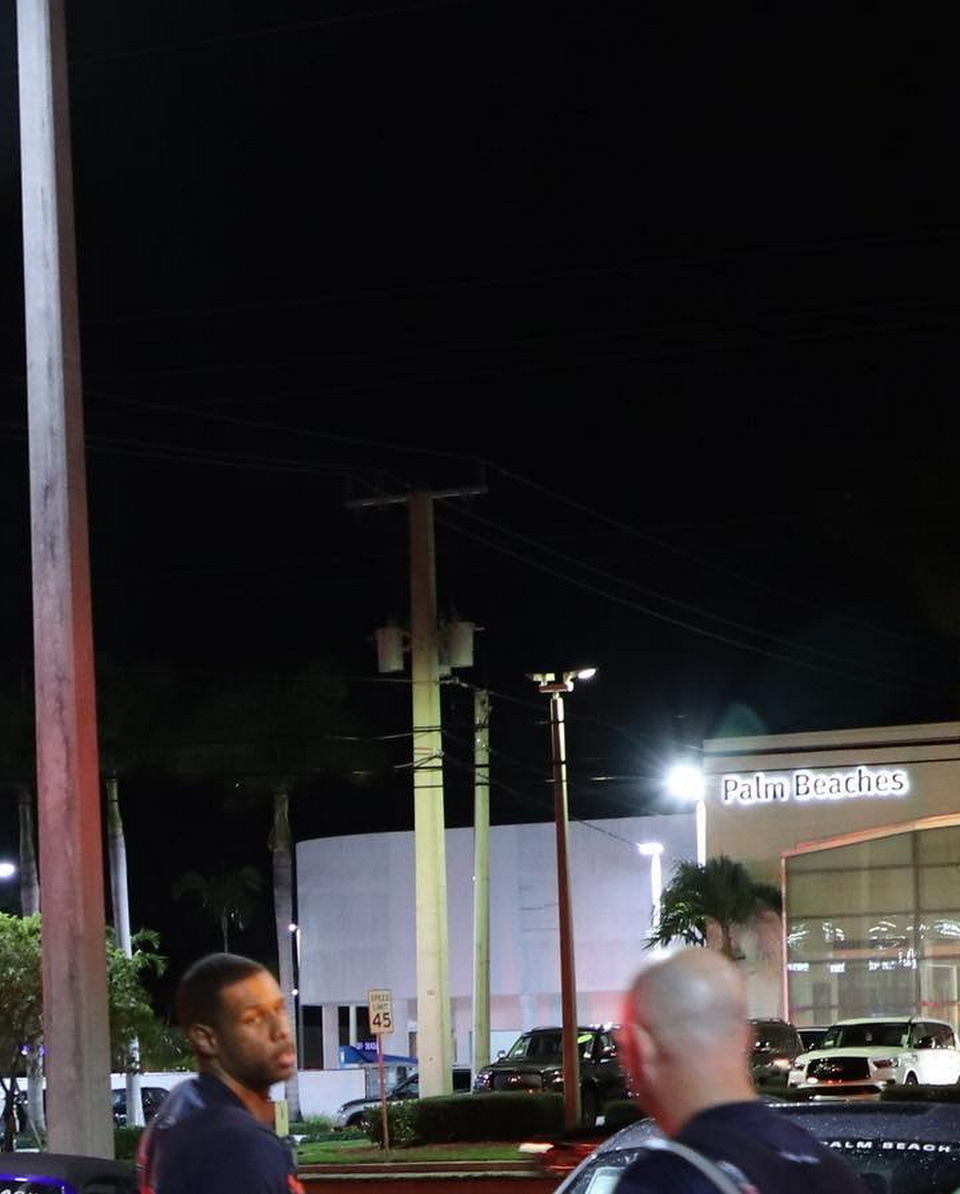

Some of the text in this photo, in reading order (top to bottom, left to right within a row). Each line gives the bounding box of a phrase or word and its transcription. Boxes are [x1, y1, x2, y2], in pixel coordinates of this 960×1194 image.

[722, 767, 906, 801] Palm Beaches
[372, 1012, 392, 1028] 45
[882, 1141, 951, 1153] BEACH
